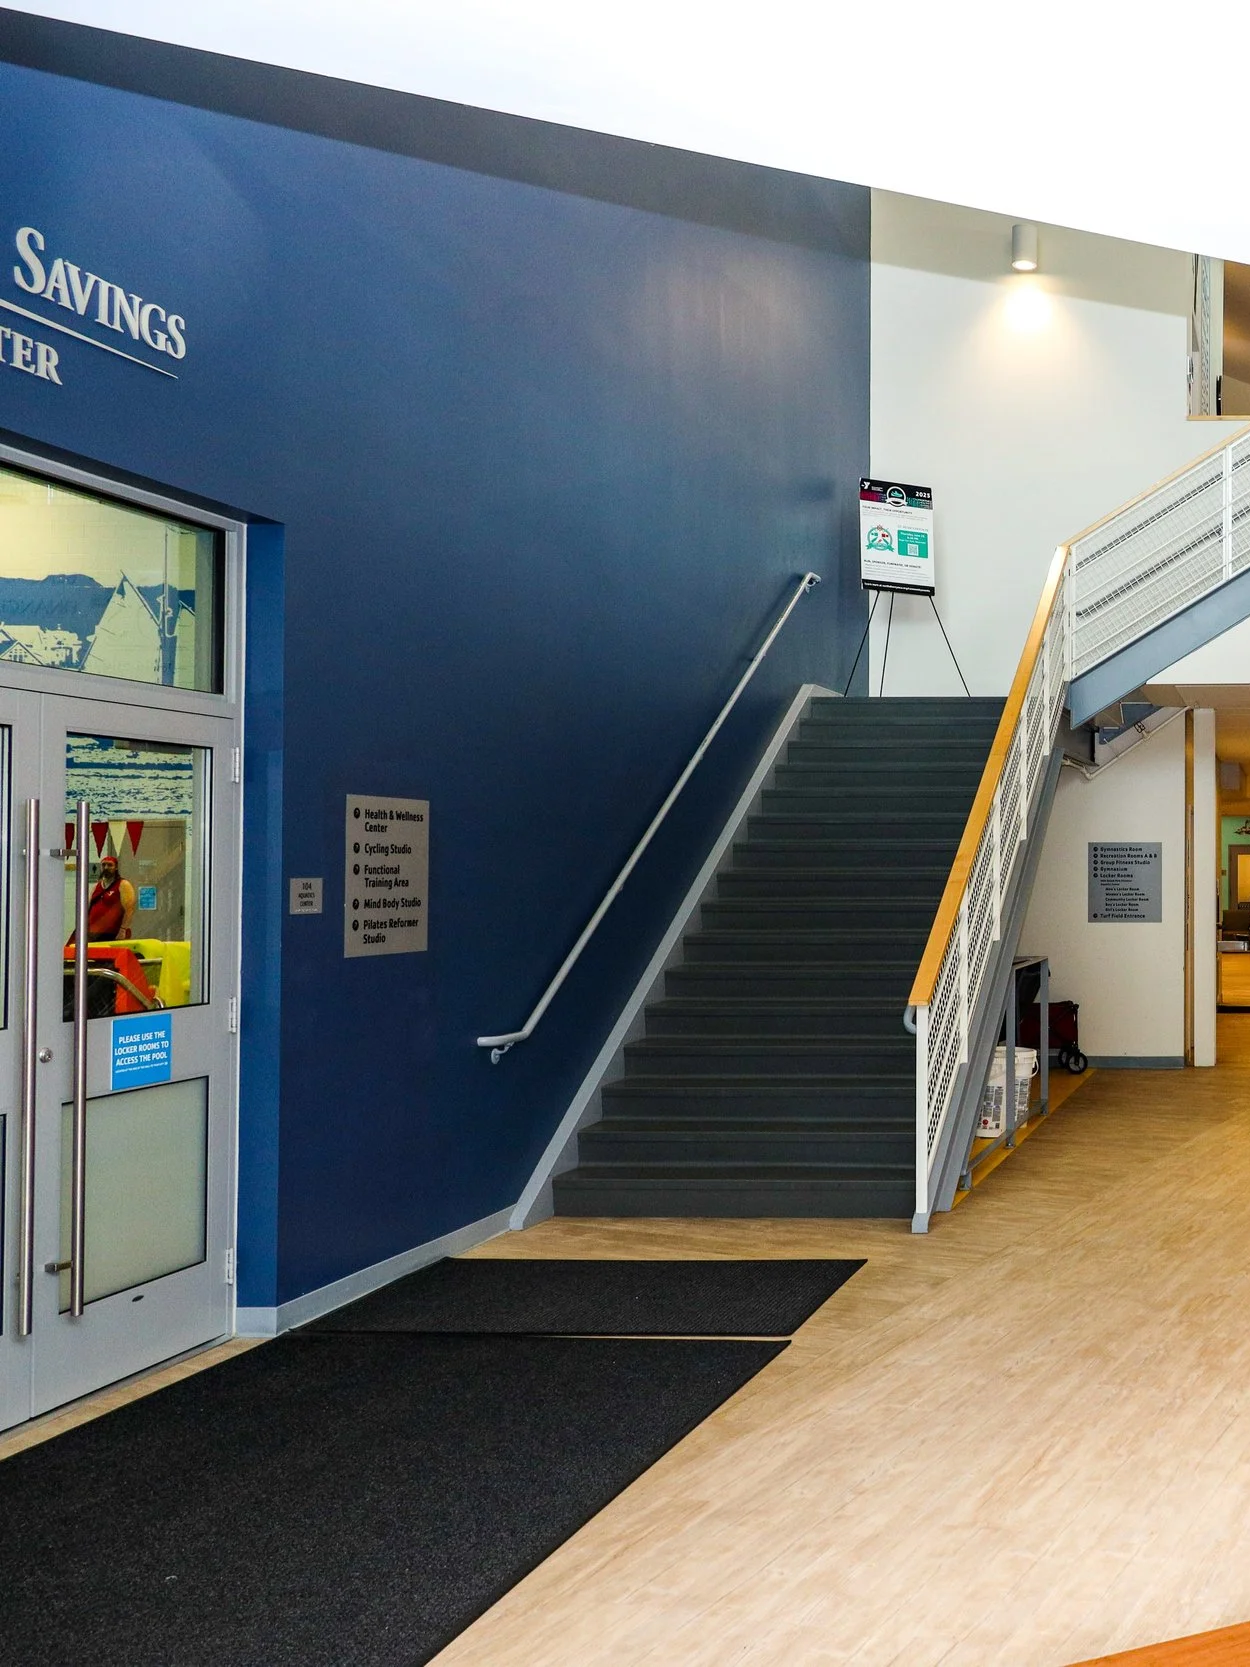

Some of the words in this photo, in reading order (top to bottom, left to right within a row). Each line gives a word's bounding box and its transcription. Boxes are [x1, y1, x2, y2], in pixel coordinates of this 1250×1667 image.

[13, 226, 187, 360] SAVINGS
[365, 809, 388, 820] Health
[389, 810, 395, 821] &
[396, 811, 424, 822] Wellness
[365, 821, 388, 832] Center
[364, 843, 389, 856] Cycling
[390, 844, 412, 854] Studio
[364, 864, 400, 875] Functional
[364, 877, 393, 890] Training
[394, 877, 409, 887] Area
[364, 898, 381, 909] Mind
[382, 898, 399, 910] Body
[400, 897, 421, 908] Studio
[363, 919, 387, 930] Pilates
[389, 917, 419, 928] Reformer
[363, 933, 386, 944] Studio
[119, 1034, 140, 1044] PLEASE
[142, 1032, 153, 1040] USE
[115, 1045, 137, 1055] LOCKER
[139, 1042, 160, 1051] ROOMS
[116, 1056, 138, 1066] ACCESS
[140, 1054, 151, 1062] THE
[152, 1052, 167, 1060] POOL
